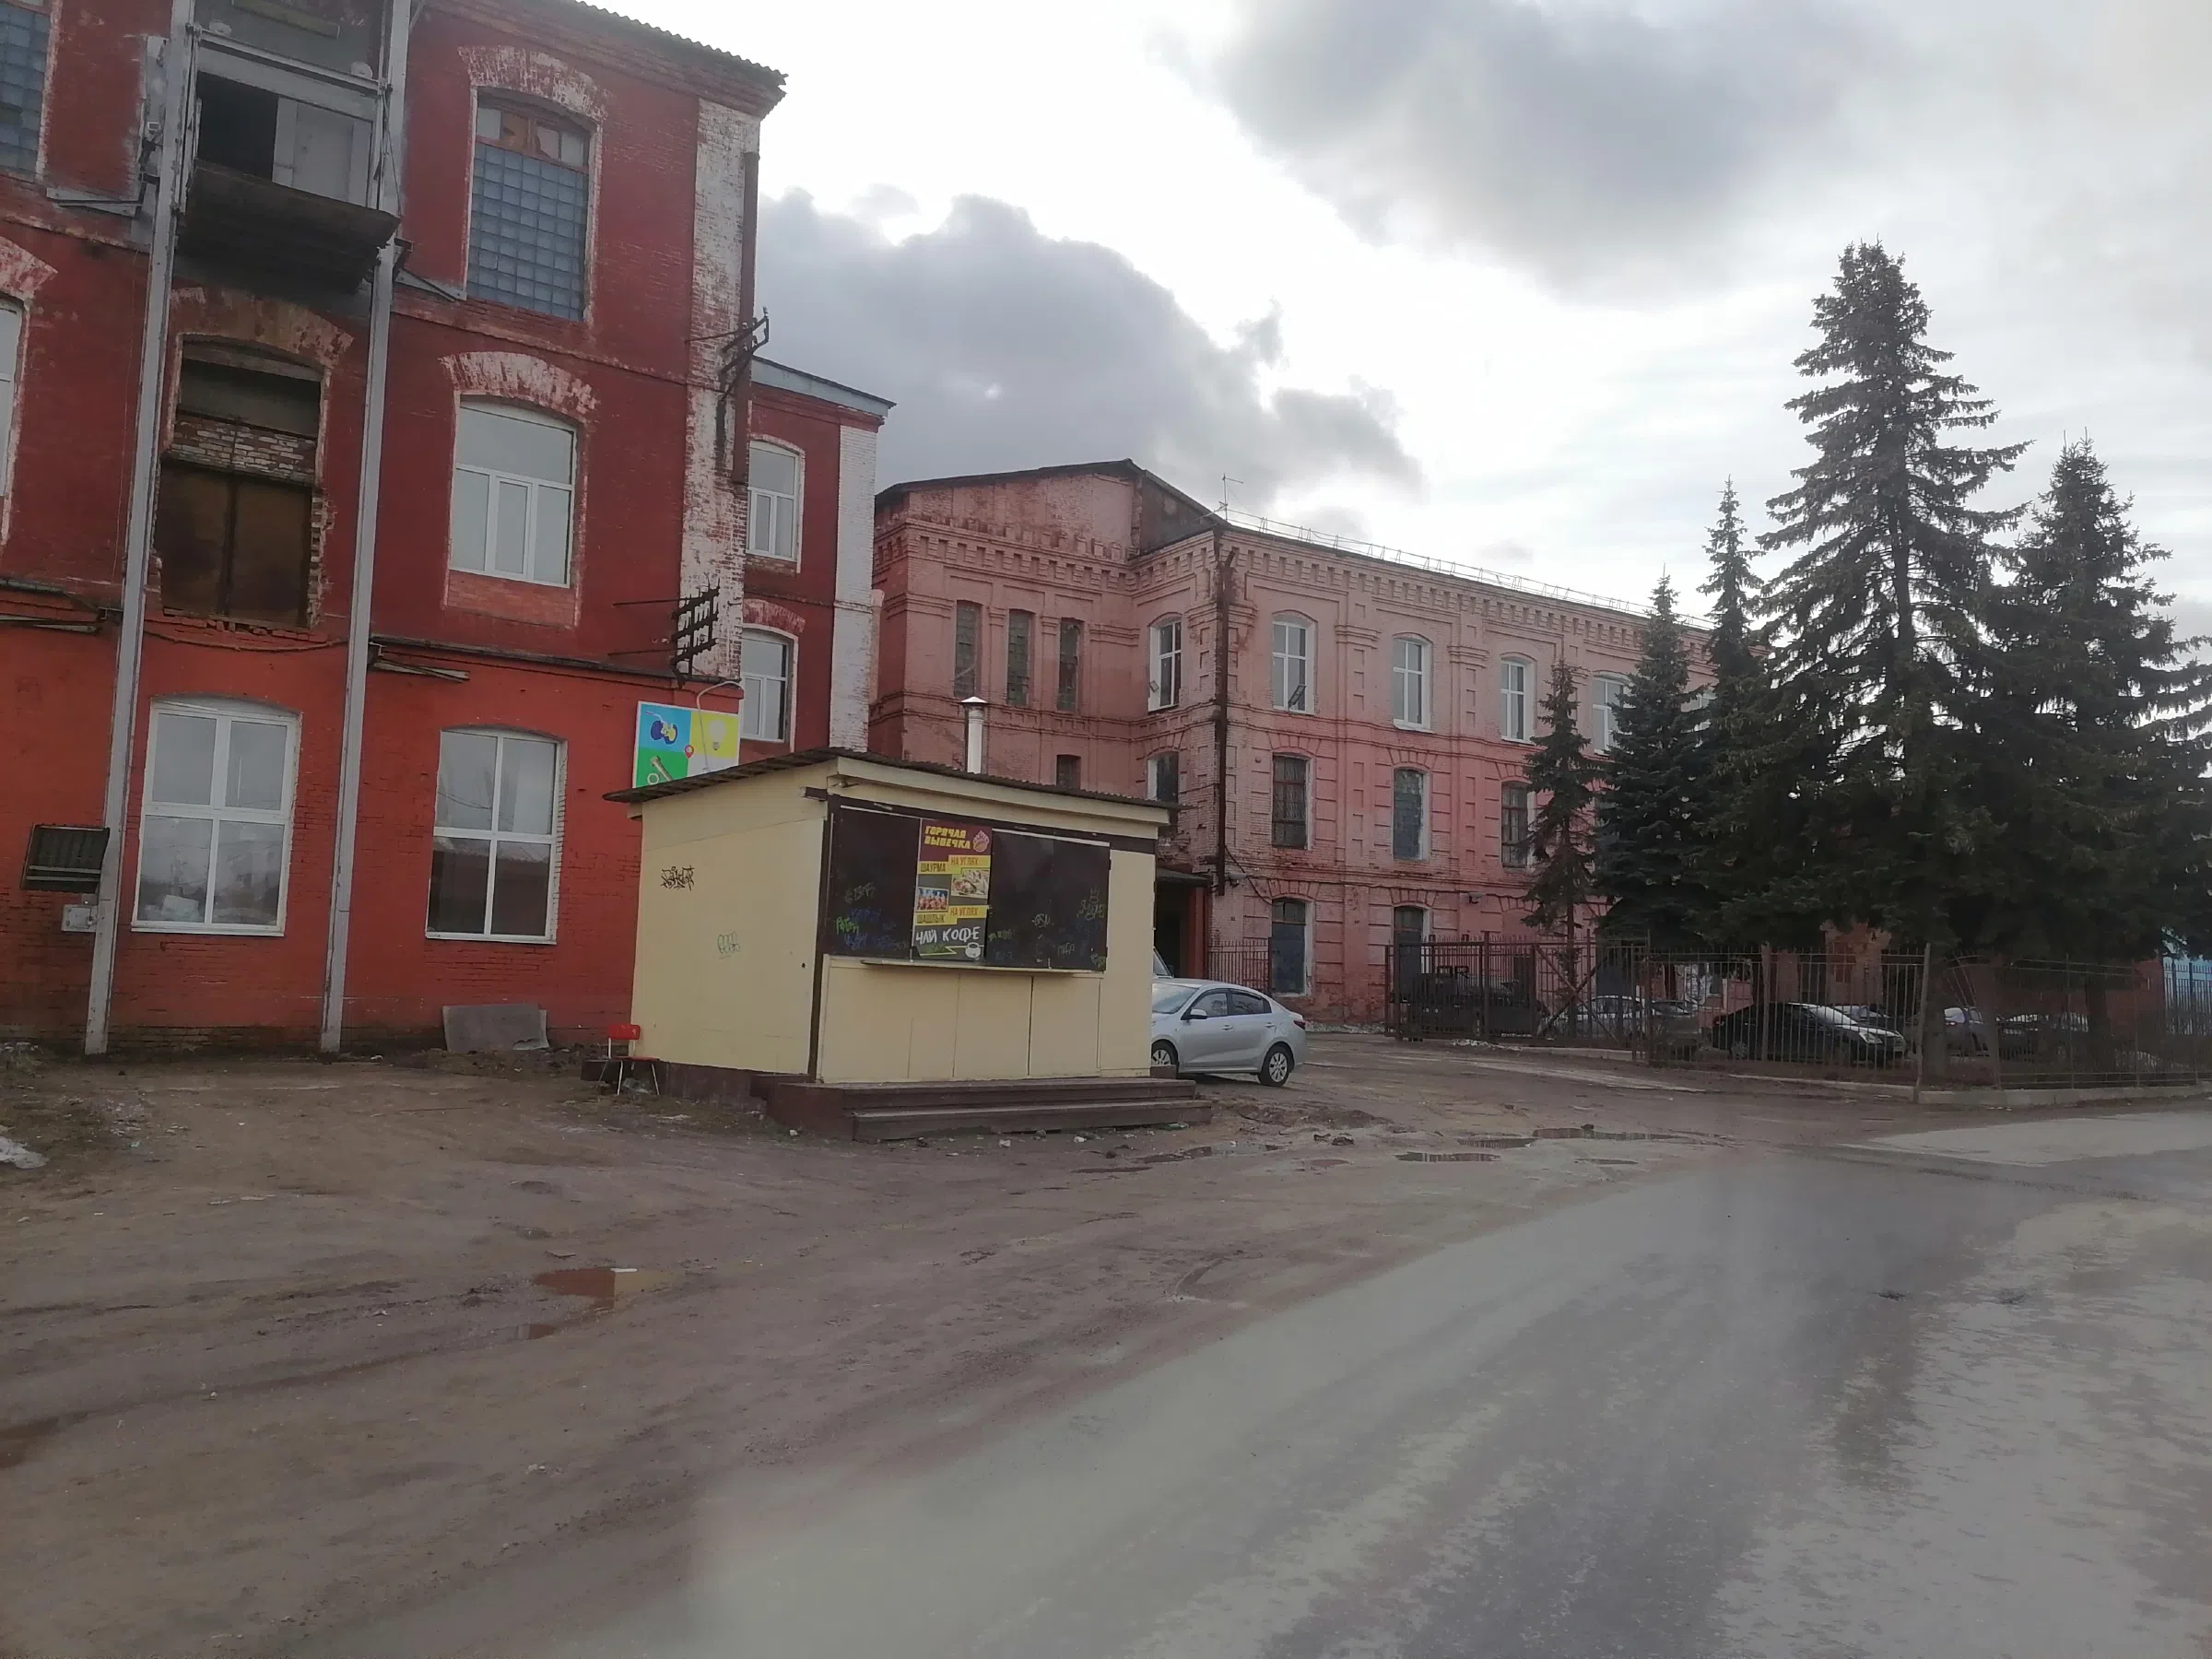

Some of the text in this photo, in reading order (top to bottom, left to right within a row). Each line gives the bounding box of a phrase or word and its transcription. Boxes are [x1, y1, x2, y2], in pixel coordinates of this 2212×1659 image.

[924, 825, 967, 840] ГОРЯЧАЯ
[924, 835, 971, 850] ВЫПЕЧКА
[951, 856, 979, 866] НА УГЛЯХ
[920, 863, 947, 872] ШАУРМА
[950, 907, 979, 916] НА УГЛЯХ
[916, 914, 945, 924] ШАШЛЫК
[915, 929, 937, 945] ЧАЙ
[942, 926, 981, 942] КОФЕ
